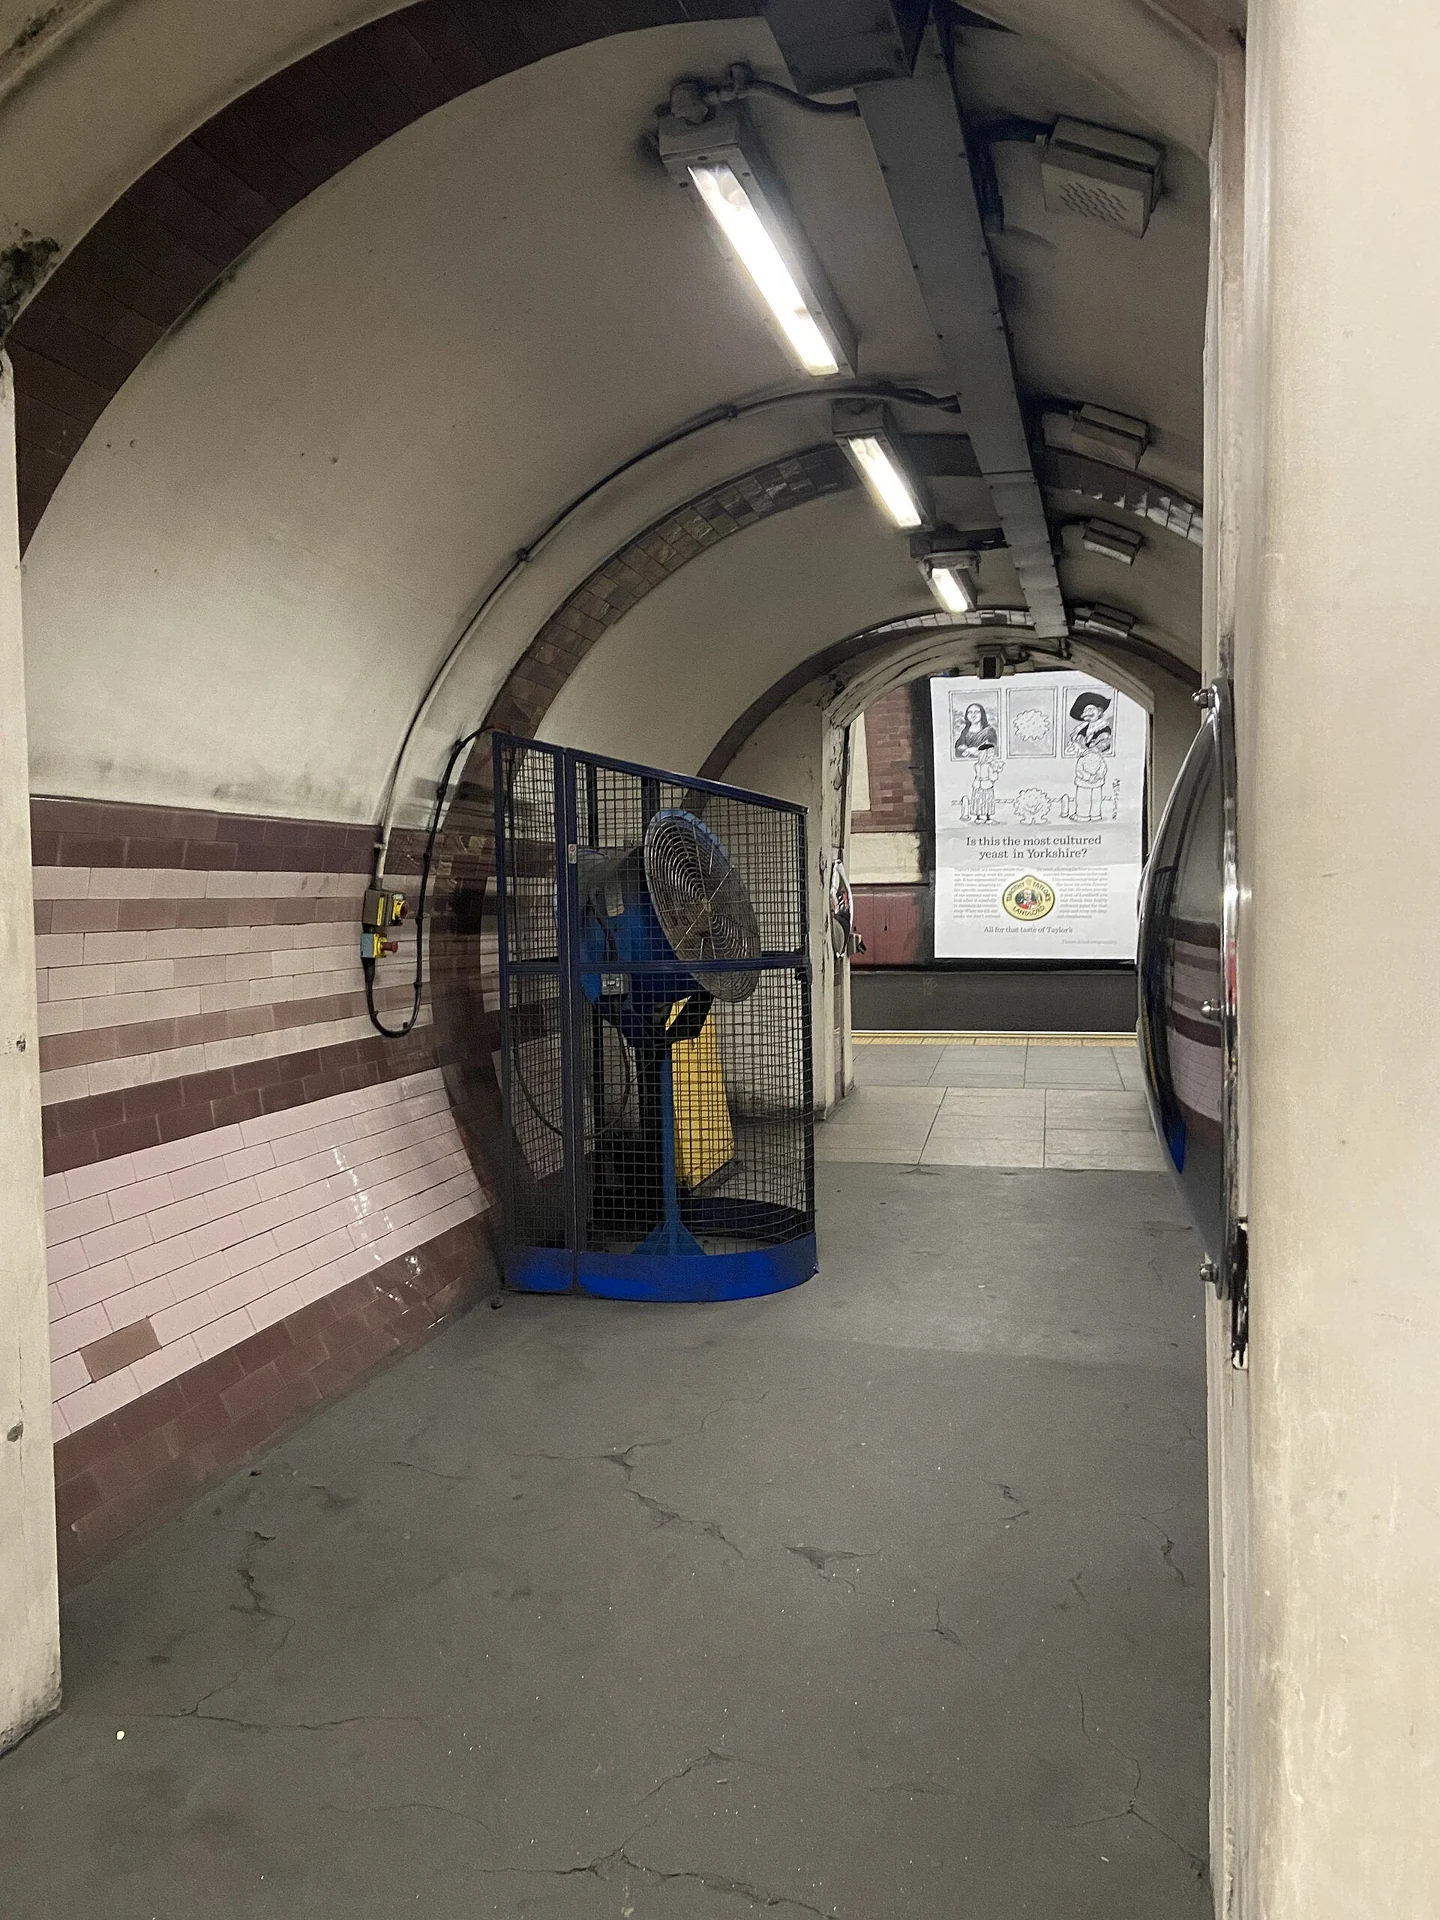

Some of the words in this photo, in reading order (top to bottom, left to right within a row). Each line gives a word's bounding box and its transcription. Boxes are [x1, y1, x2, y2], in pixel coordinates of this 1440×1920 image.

[965, 836, 976, 846] Is
[979, 836, 1000, 846] this
[1002, 836, 1021, 846] the
[1023, 836, 1051, 846] most
[1053, 834, 1102, 846] cultured
[979, 850, 1009, 861] yeast
[1013, 848, 1024, 859] in
[1027, 848, 1088, 859] Yorkshire?
[1012, 905, 1045, 916] LANDLORD
[1047, 926, 1073, 935] Taylor's
